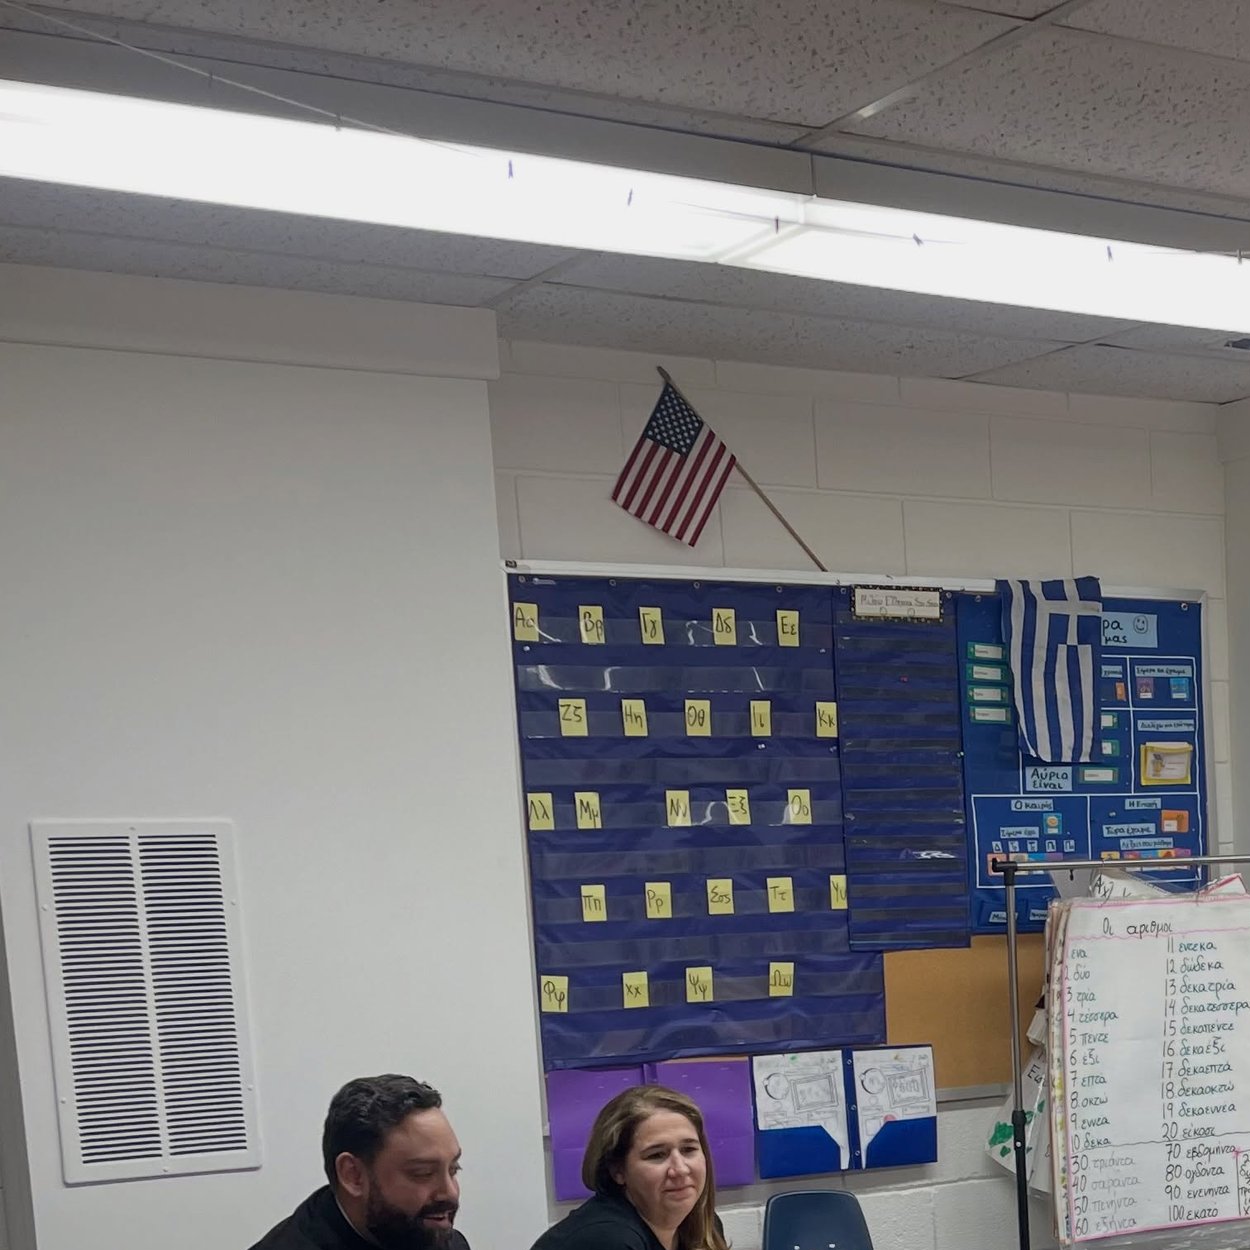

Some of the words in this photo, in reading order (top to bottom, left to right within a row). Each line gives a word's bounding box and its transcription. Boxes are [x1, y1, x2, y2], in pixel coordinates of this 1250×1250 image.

[584, 612, 604, 636] Ββ
[643, 613, 657, 636] Γγ
[716, 616, 732, 633] Δδ
[781, 616, 797, 635] Εε
[624, 706, 643, 728] Ηη
[688, 706, 705, 724] Θθ
[1031, 768, 1068, 780] Αύριο
[530, 799, 550, 820] Λλ
[579, 799, 599, 827] Μμ
[647, 889, 664, 913] Ρρ
[770, 886, 787, 901] Ττ
[583, 895, 602, 911] Ππ
[1103, 917, 1114, 936] Οι
[1167, 936, 1174, 953] 11
[1166, 958, 1177, 975] 12
[770, 969, 792, 987] Ωω
[543, 980, 566, 1009] Φφ
[689, 974, 708, 1000] Ψψ
[1067, 987, 1073, 1002] 3
[1165, 979, 1176, 996] 13
[1180, 974, 1236, 1000] δεκατρία
[1067, 1008, 1075, 1022] 4
[1165, 999, 1176, 1017] 14
[1070, 1028, 1077, 1045] 5
[1164, 1020, 1176, 1036] 15
[1070, 1049, 1077, 1065] 6
[1162, 1062, 1174, 1078] 17
[1070, 1071, 1077, 1087] 7
[1162, 1102, 1174, 1119] 19
[1162, 1121, 1178, 1140] 20
[1165, 1143, 1181, 1159] 70
